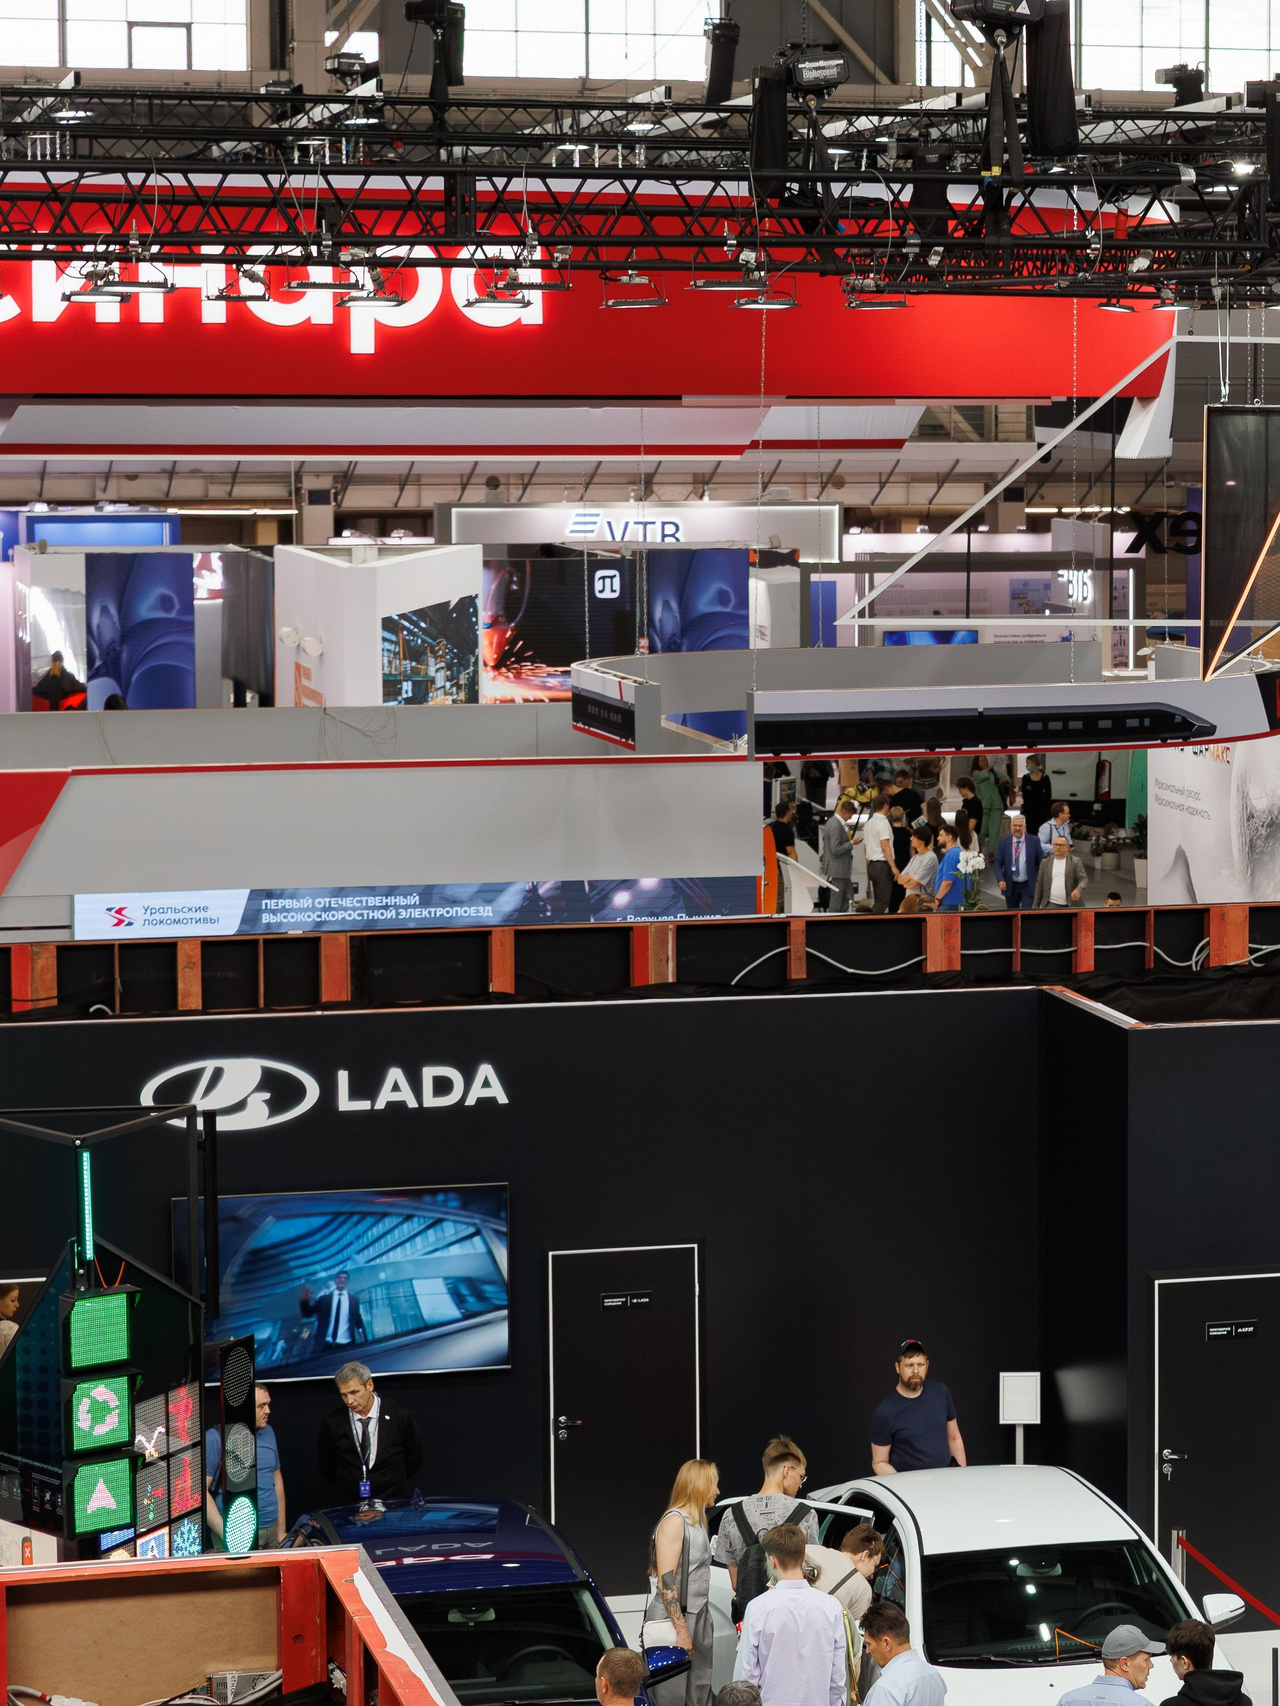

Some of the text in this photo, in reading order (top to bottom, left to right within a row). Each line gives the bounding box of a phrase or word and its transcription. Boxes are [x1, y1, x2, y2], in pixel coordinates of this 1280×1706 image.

[0, 240, 544, 354] инара
[606, 521, 682, 542] VTB
[142, 904, 209, 915] Уральские
[261, 893, 419, 910] ПЕРВЫЙ ОТЕЧЕСТВЕННЫЙ
[142, 916, 220, 927] локомотивы
[261, 906, 493, 923] ВЫСОКОСКОРОСТНОЙ ЭЛЕКТРОПОЕЗД
[338, 1063, 509, 1111] LADA
